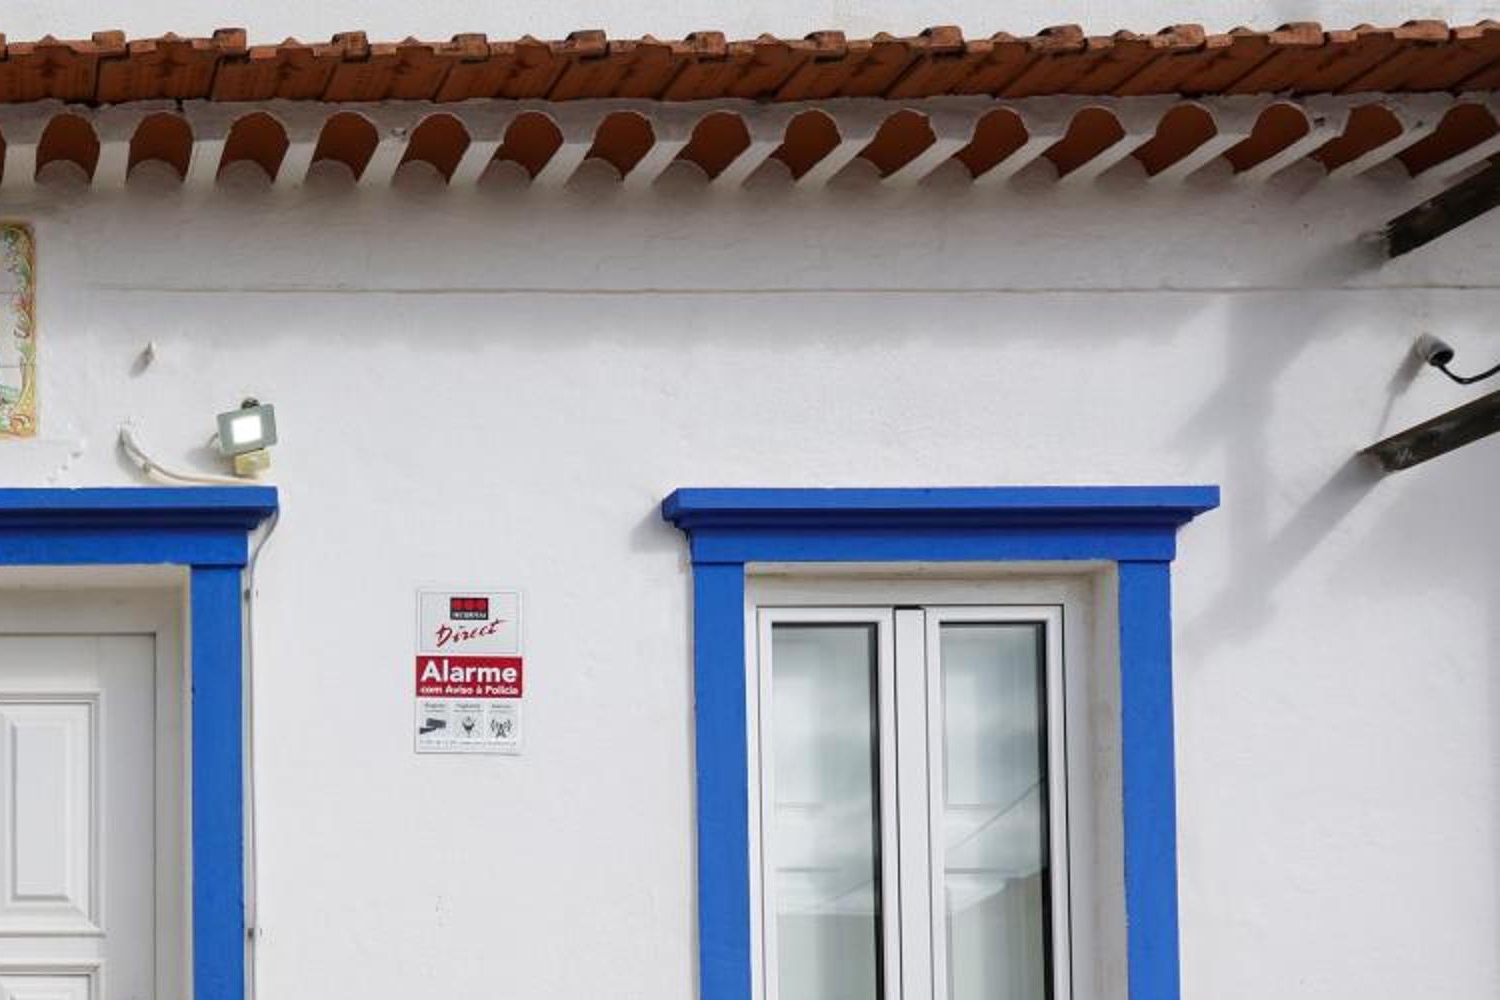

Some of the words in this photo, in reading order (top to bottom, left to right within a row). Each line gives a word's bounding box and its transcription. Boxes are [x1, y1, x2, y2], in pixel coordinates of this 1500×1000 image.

[420, 658, 517, 683] Alarme
[420, 686, 443, 694] com
[445, 685, 475, 694] Aviso
